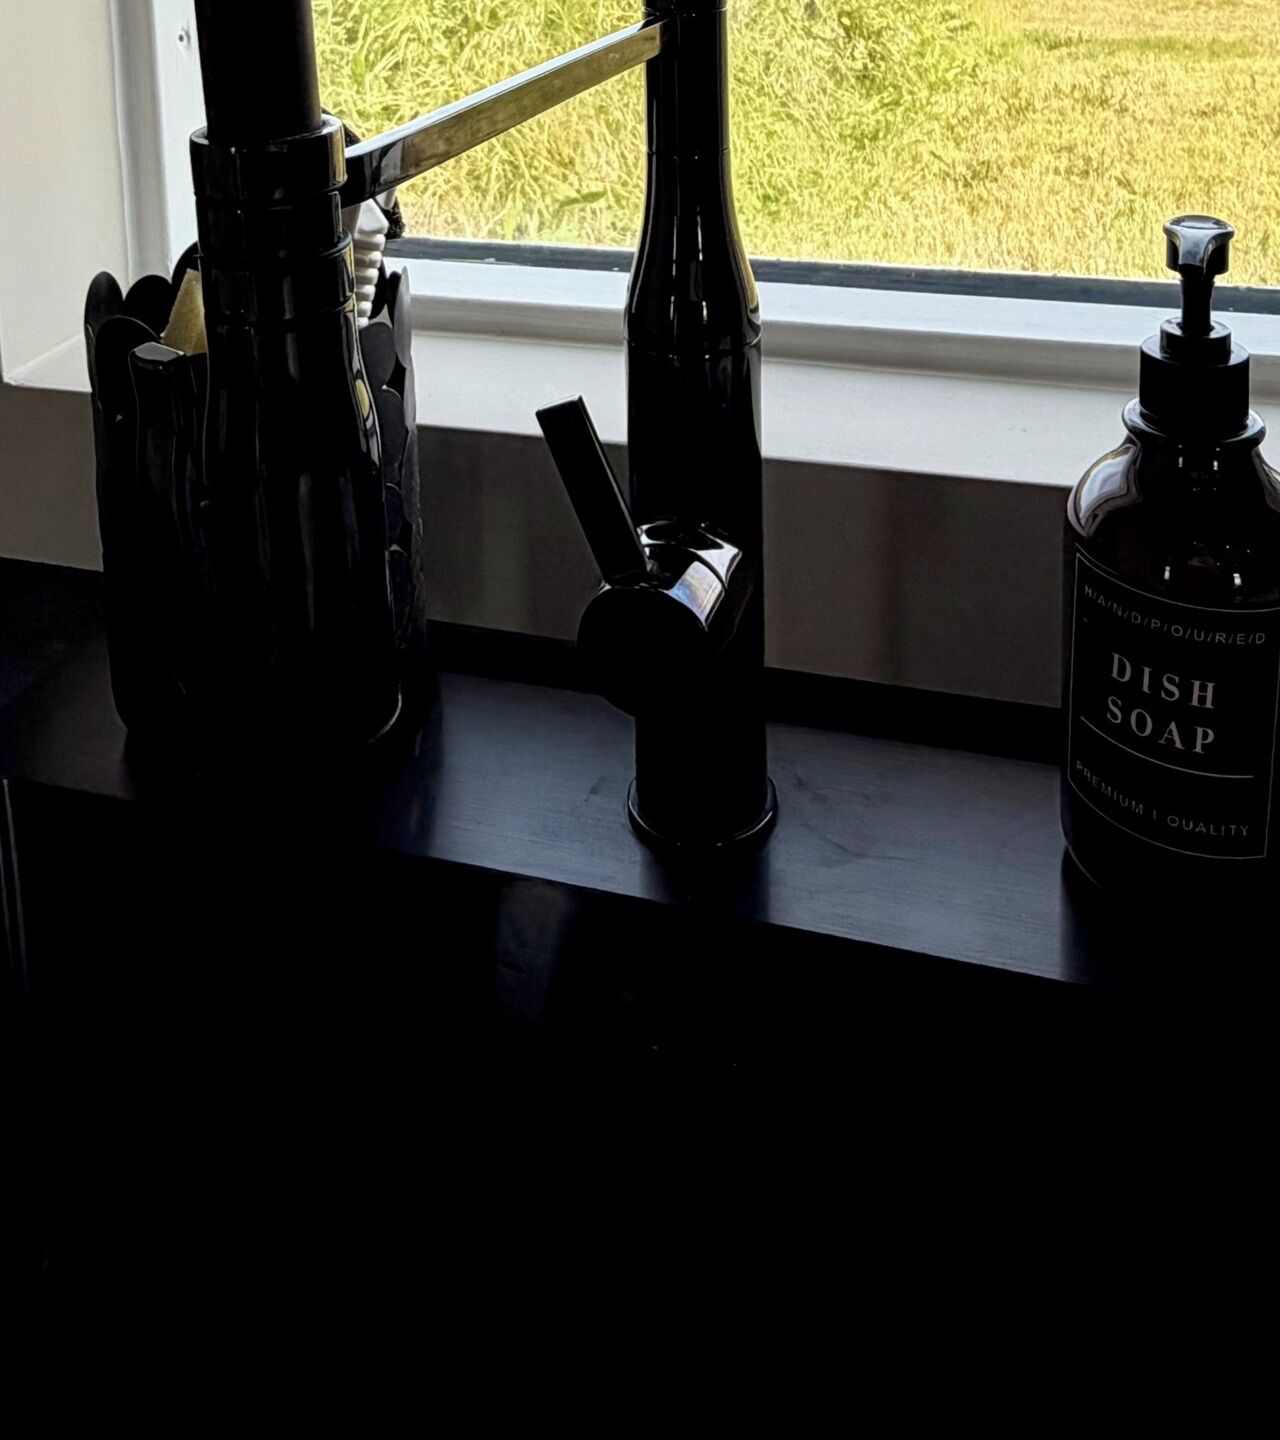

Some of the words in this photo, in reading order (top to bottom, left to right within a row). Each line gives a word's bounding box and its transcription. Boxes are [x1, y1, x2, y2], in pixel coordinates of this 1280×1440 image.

[1109, 651, 1216, 710] DISH
[1106, 695, 1216, 754] SOAP
[1075, 760, 1144, 816] PREMIUM
[1166, 815, 1249, 837] QUALITY
